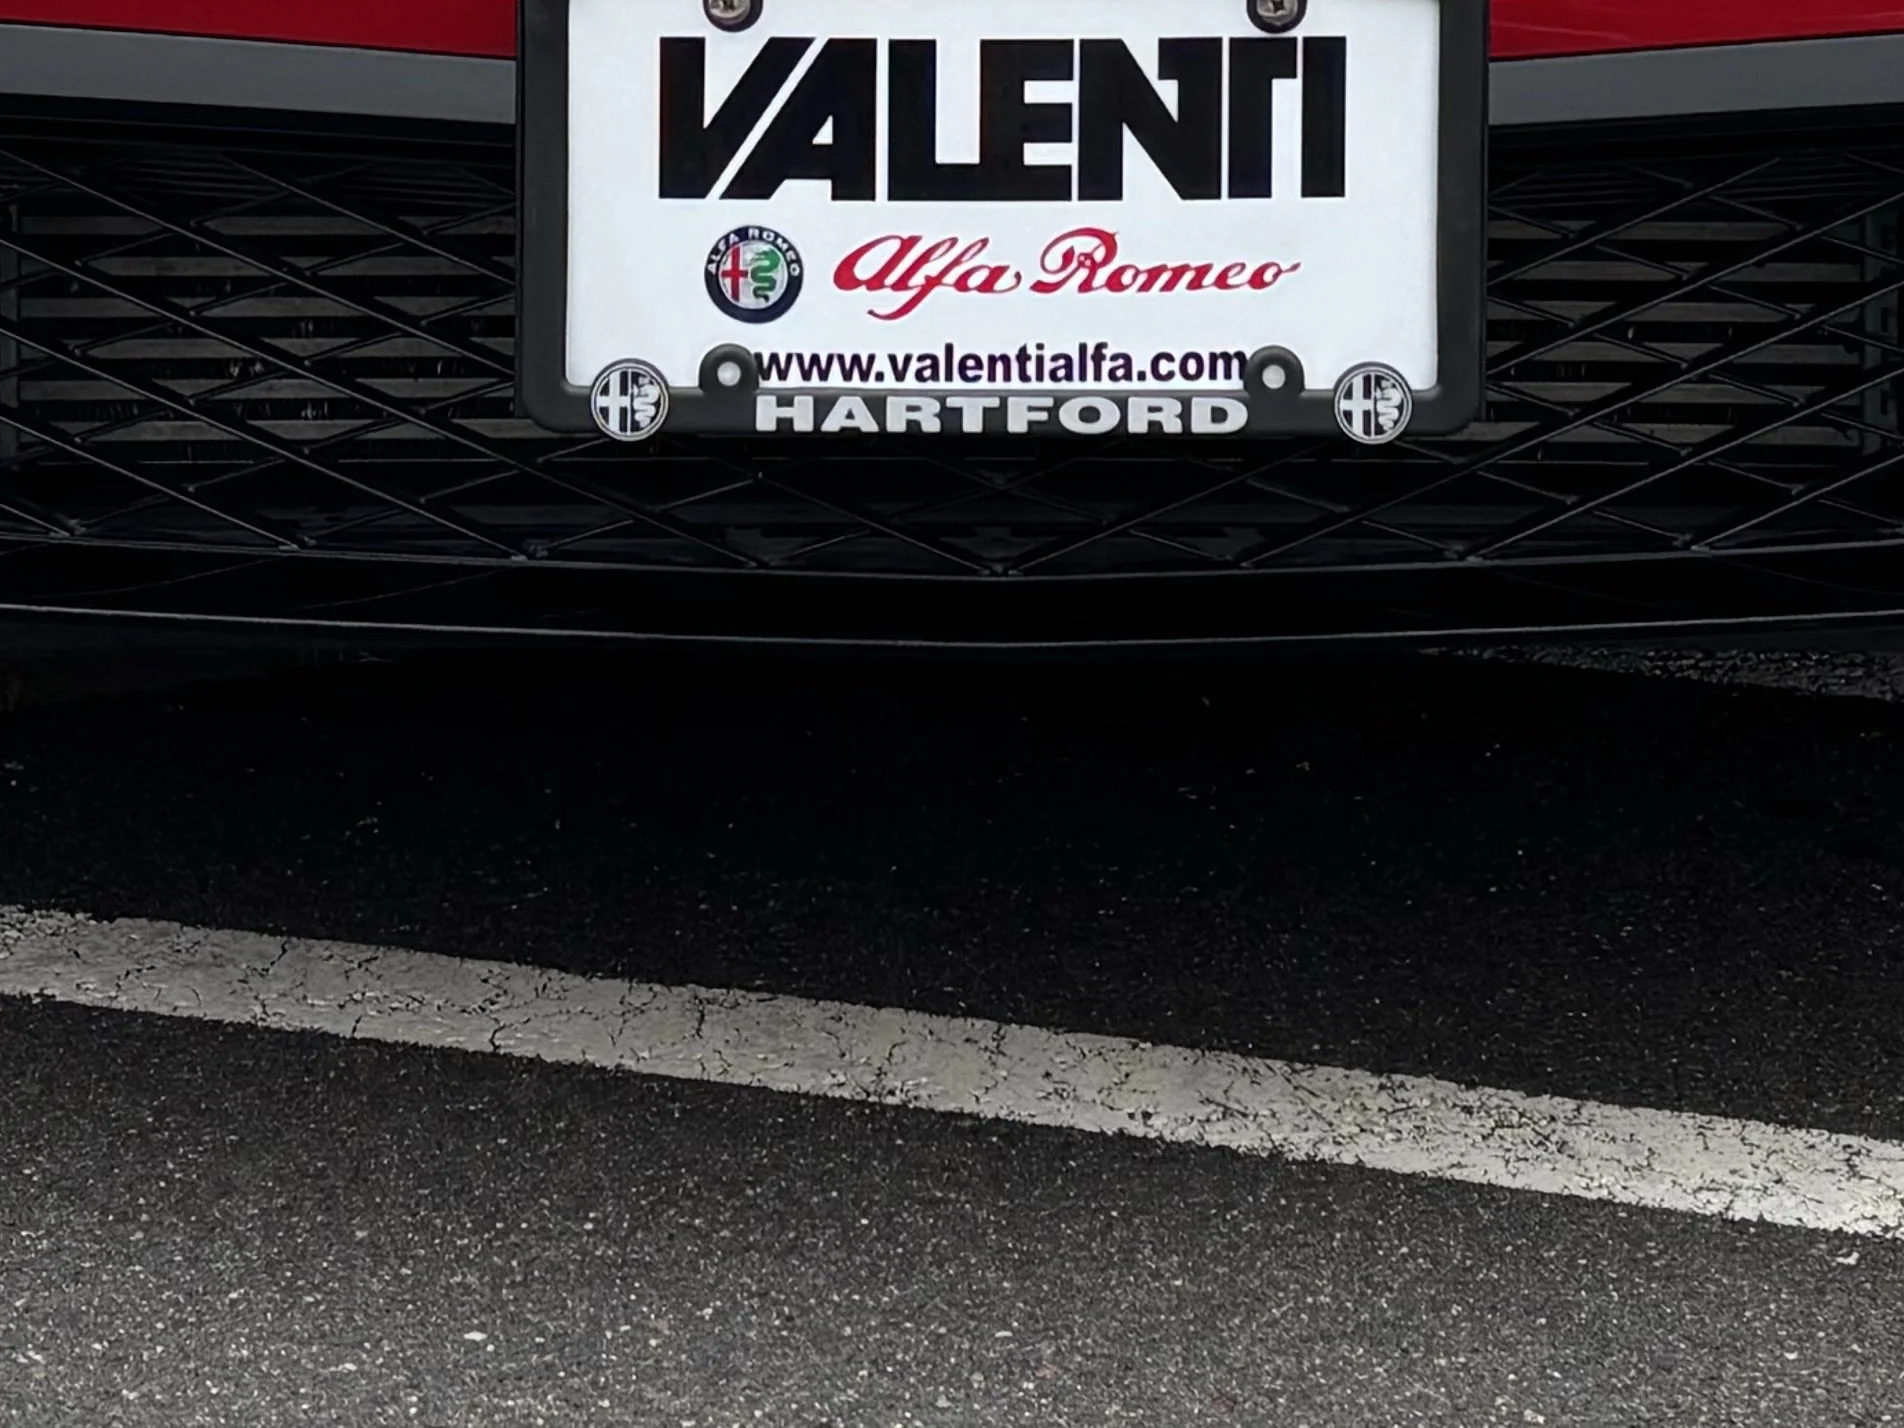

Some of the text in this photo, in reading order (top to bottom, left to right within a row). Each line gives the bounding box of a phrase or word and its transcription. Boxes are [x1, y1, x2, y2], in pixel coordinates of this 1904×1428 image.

[657, 36, 1347, 202] VALENTI
[707, 227, 801, 276] ALFA ROMEO
[832, 227, 1302, 321] Alfa Romeo
[754, 341, 1248, 383] www.valentialfa.com
[754, 394, 1249, 435] HARTFORD
